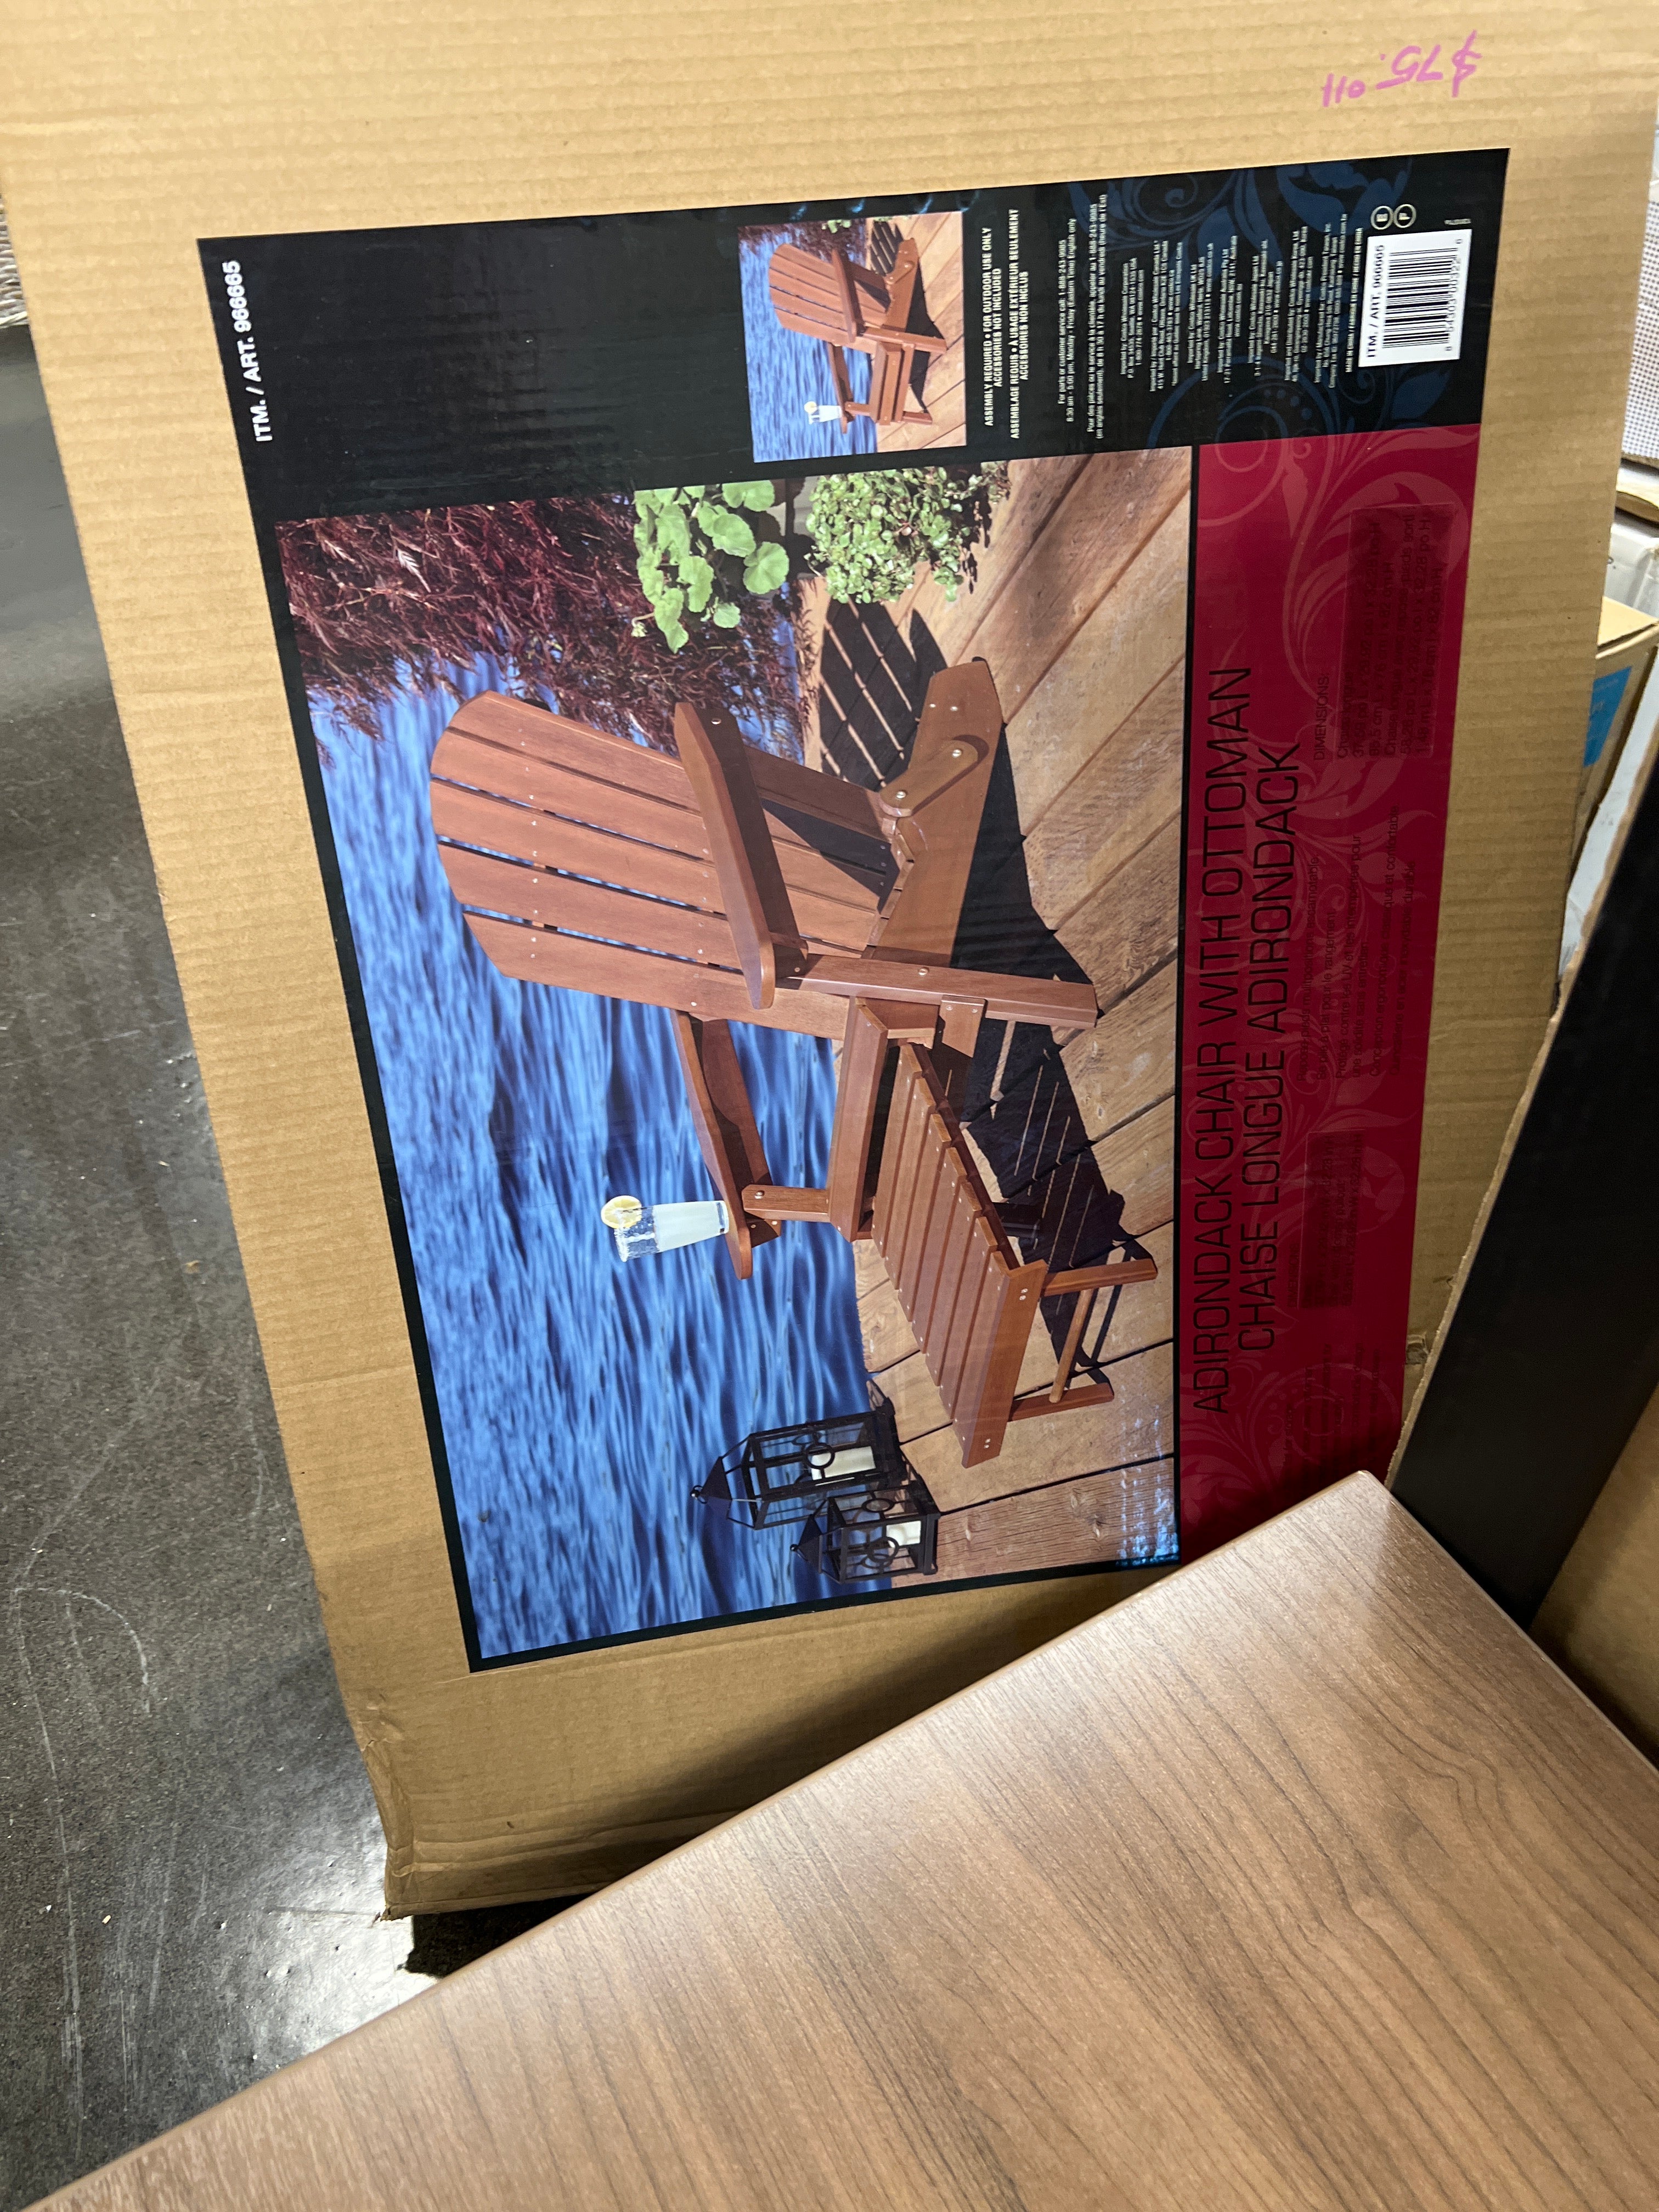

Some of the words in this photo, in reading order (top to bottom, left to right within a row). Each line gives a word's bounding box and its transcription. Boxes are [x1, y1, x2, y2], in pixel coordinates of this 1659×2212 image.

[1067, 218, 1077, 233] only
[1098, 213, 1107, 222] de
[981, 227, 992, 251] ONLY
[1008, 208, 1019, 260] SEULEMENT
[1067, 234, 1076, 258] English
[1098, 223, 1107, 245] (heure
[981, 252, 992, 269] USE
[1088, 262, 1097, 271] au
[1097, 246, 1107, 275] vendredi
[981, 272, 992, 313] OUTDOOR
[992, 268, 1002, 311] INCLUDED
[1007, 262, 1019, 308] EXTÉRIEUR
[1019, 271, 1028, 302] INCLUS
[1088, 273, 1097, 297] appeler
[1097, 276, 1106, 285] au
[222, 260, 252, 332] 966665
[1097, 286, 1106, 303] lundi
[1369, 292, 1381, 319] ART.
[992, 312, 1002, 329] NOT
[1019, 304, 1028, 322] NON
[1066, 308, 1076, 329] Friday
[1097, 304, 1105, 313] du
[983, 314, 992, 332] FOR
[1009, 311, 1019, 338] USAGE
[1058, 313, 1066, 335] service
[1019, 324, 1029, 380] ACCESSOIRES
[1058, 337, 1066, 366] customer
[1066, 334, 1075, 360] Monday
[1097, 336, 1105, 345] 30
[1366, 331, 1378, 357] ITM.
[237, 337, 262, 382] ART.
[983, 340, 993, 381] REQUIRED
[992, 331, 1003, 387] ACCESSORIES
[1087, 342, 1096, 365] service
[1096, 358, 1105, 366] de
[1009, 353, 1019, 384] REQUIS
[1087, 374, 1096, 382] ou
[245, 386, 264, 395] /
[1057, 376, 1066, 392] parts
[984, 383, 994, 426] ASSEMBLY
[1057, 393, 1066, 404] For
[1066, 396, 1075, 406] am
[1087, 405, 1095, 416] des
[250, 399, 272, 442] ITM.
[1010, 386, 1019, 439] ASSEMBLAGE
[1086, 417, 1095, 432] Pour
[1096, 405, 1104, 427] anglais
[1096, 428, 1104, 438] (en
[1203, 667, 1250, 896] OTTOMAN
[1247, 743, 1300, 1032] ADIRONDACK
[1200, 913, 1242, 1026] WITH
[1197, 1041, 1237, 1160] CHAIR
[1242, 1050, 1284, 1207] LONGUE
[1193, 1179, 1232, 1413] ADIRONDACK
[1238, 1221, 1277, 1351] CHAISE
